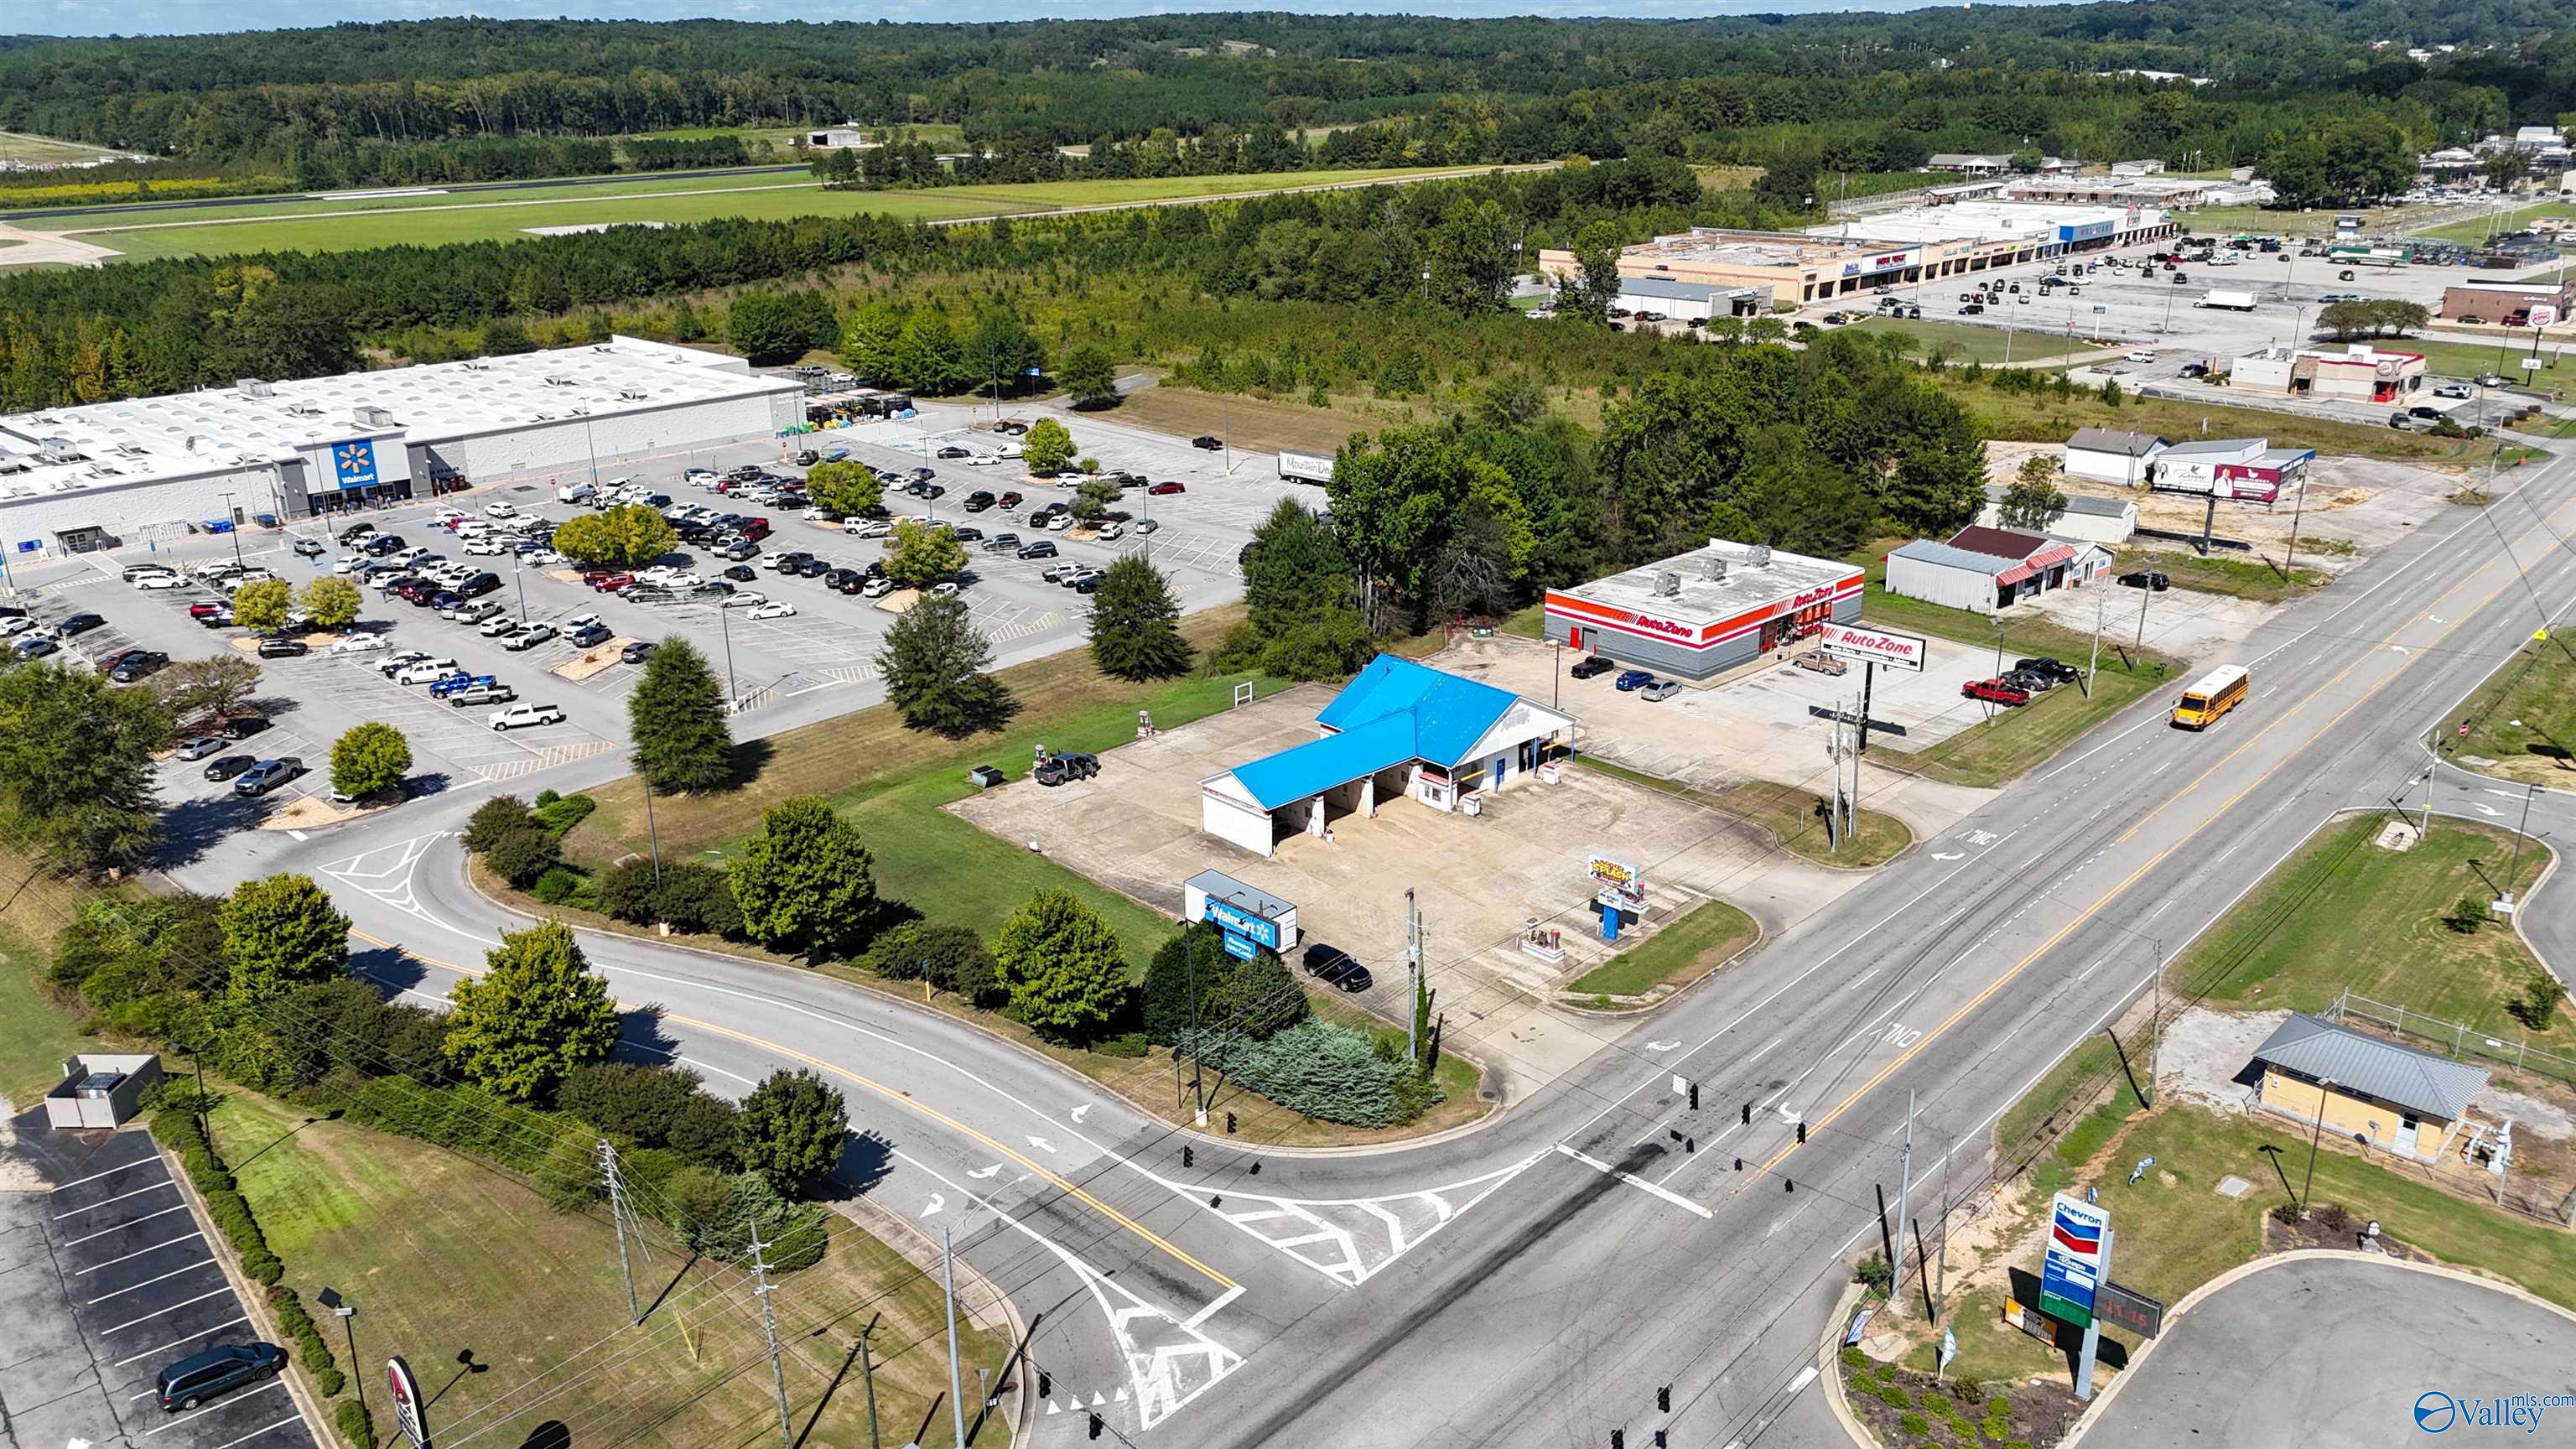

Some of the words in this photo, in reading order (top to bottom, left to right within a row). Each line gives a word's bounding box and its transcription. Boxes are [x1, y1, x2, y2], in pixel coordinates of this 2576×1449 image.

[342, 473, 375, 484] Walmart
[1791, 585, 1834, 610] AutoZone
[1636, 615, 1692, 637] AutoZone
[1841, 631, 1913, 655] AutoZone
[1212, 906, 1255, 935] Walmart
[2057, 1202, 2102, 1225] Chevron
